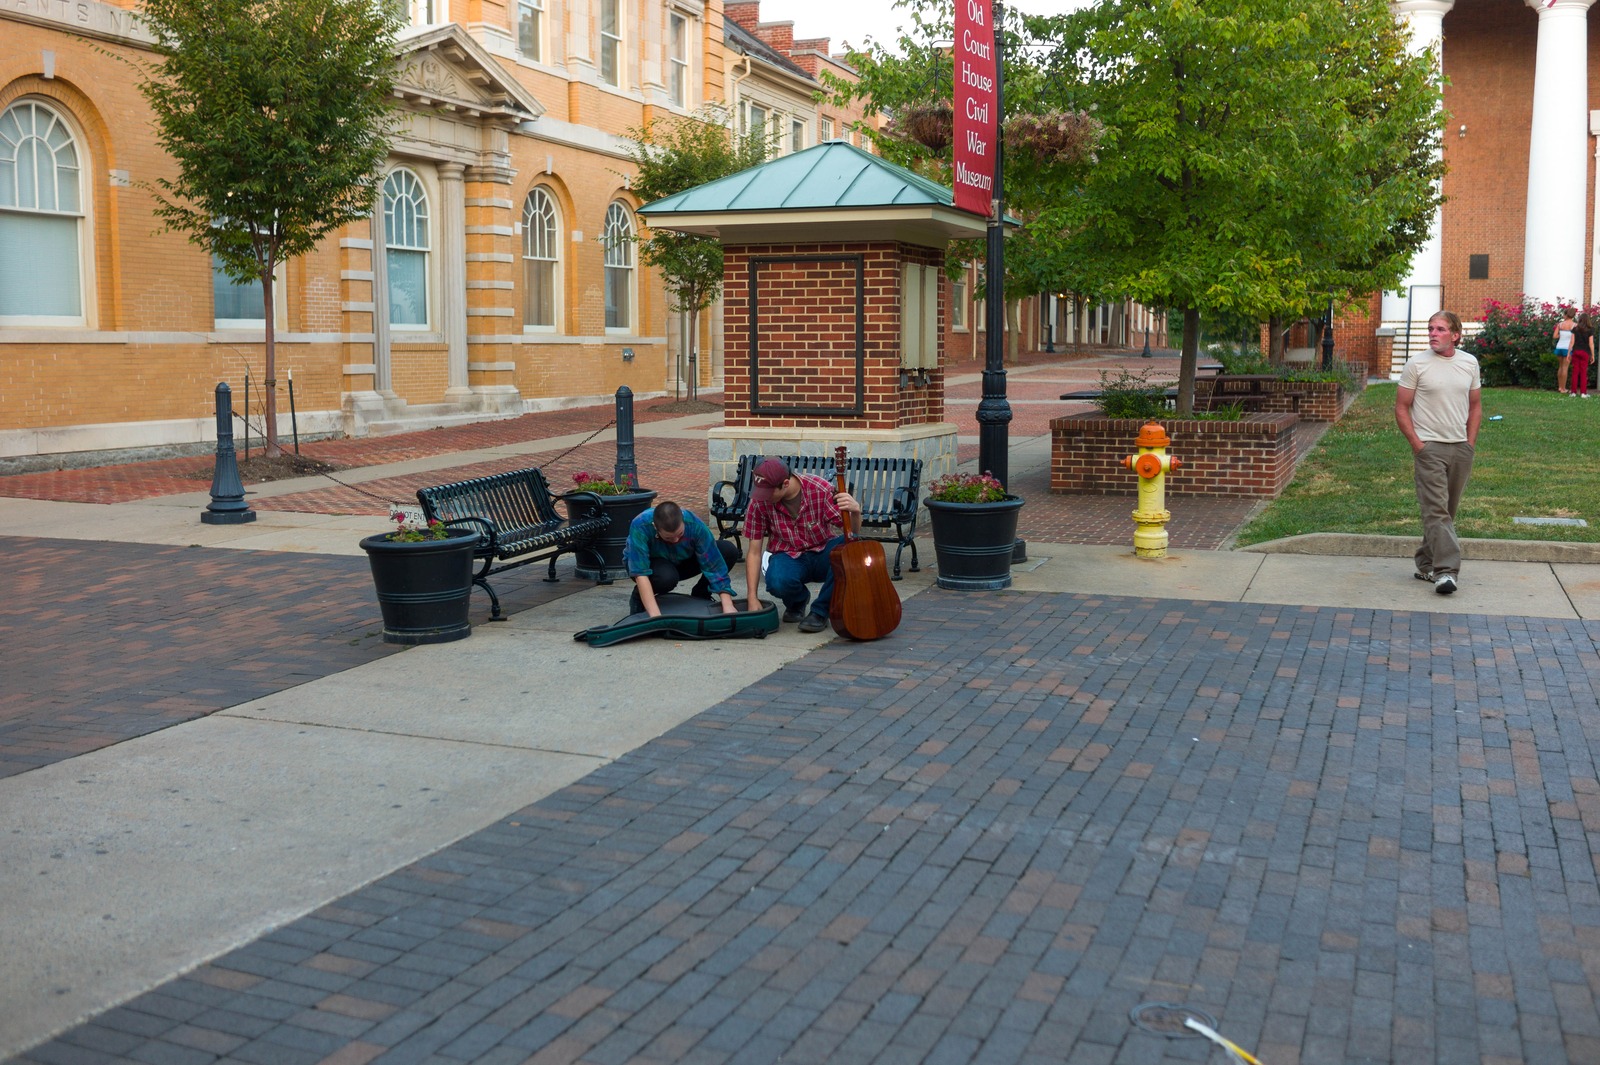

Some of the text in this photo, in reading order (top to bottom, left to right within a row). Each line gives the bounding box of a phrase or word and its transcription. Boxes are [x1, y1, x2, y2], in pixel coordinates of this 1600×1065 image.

[967, 0, 984, 26] Old
[963, 29, 990, 60] Court
[962, 61, 992, 93] House
[966, 97, 988, 124] Civil
[966, 130, 986, 156] War
[956, 161, 991, 190] Museum
[400, 510, 412, 519] OT
